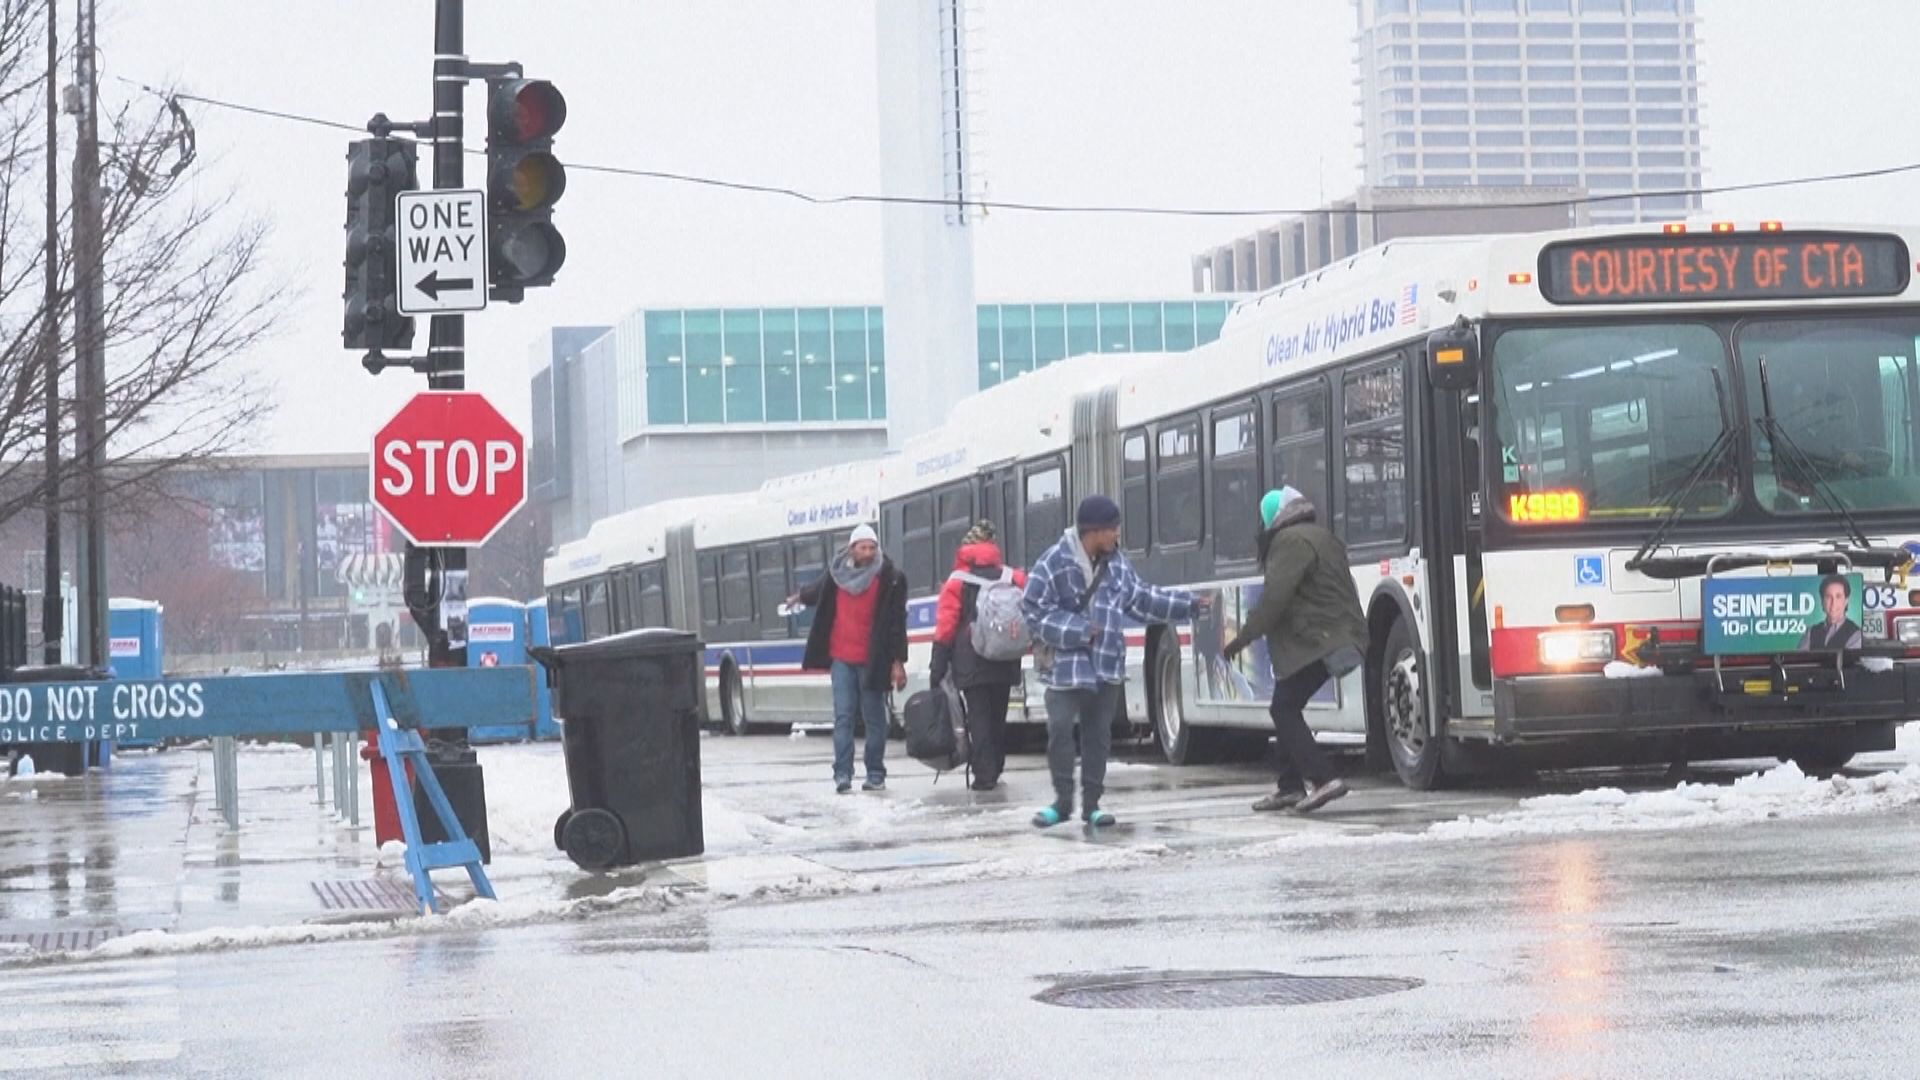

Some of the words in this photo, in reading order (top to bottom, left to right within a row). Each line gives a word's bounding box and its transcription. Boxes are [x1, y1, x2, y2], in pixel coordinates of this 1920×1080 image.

[410, 201, 473, 230] ONE
[408, 234, 475, 264] WAY
[1569, 246, 1740, 295] COURTESY
[1753, 246, 1789, 288] OF
[1801, 242, 1864, 288] CTA
[1266, 333, 1299, 367] Clean
[1302, 320, 1321, 353] Air
[1323, 303, 1367, 352] Hybrid
[1370, 298, 1396, 333] Bus
[381, 439, 517, 496] STOP
[845, 499, 859, 517] Bus
[1510, 492, 1580, 522] K999
[1712, 592, 1815, 618] SEINFELD
[0, 687, 32, 723] DO
[47, 686, 98, 721] NOT
[112, 682, 204, 720] CROSS
[1, 725, 67, 742] OLICE
[85, 723, 139, 740] DEPT
